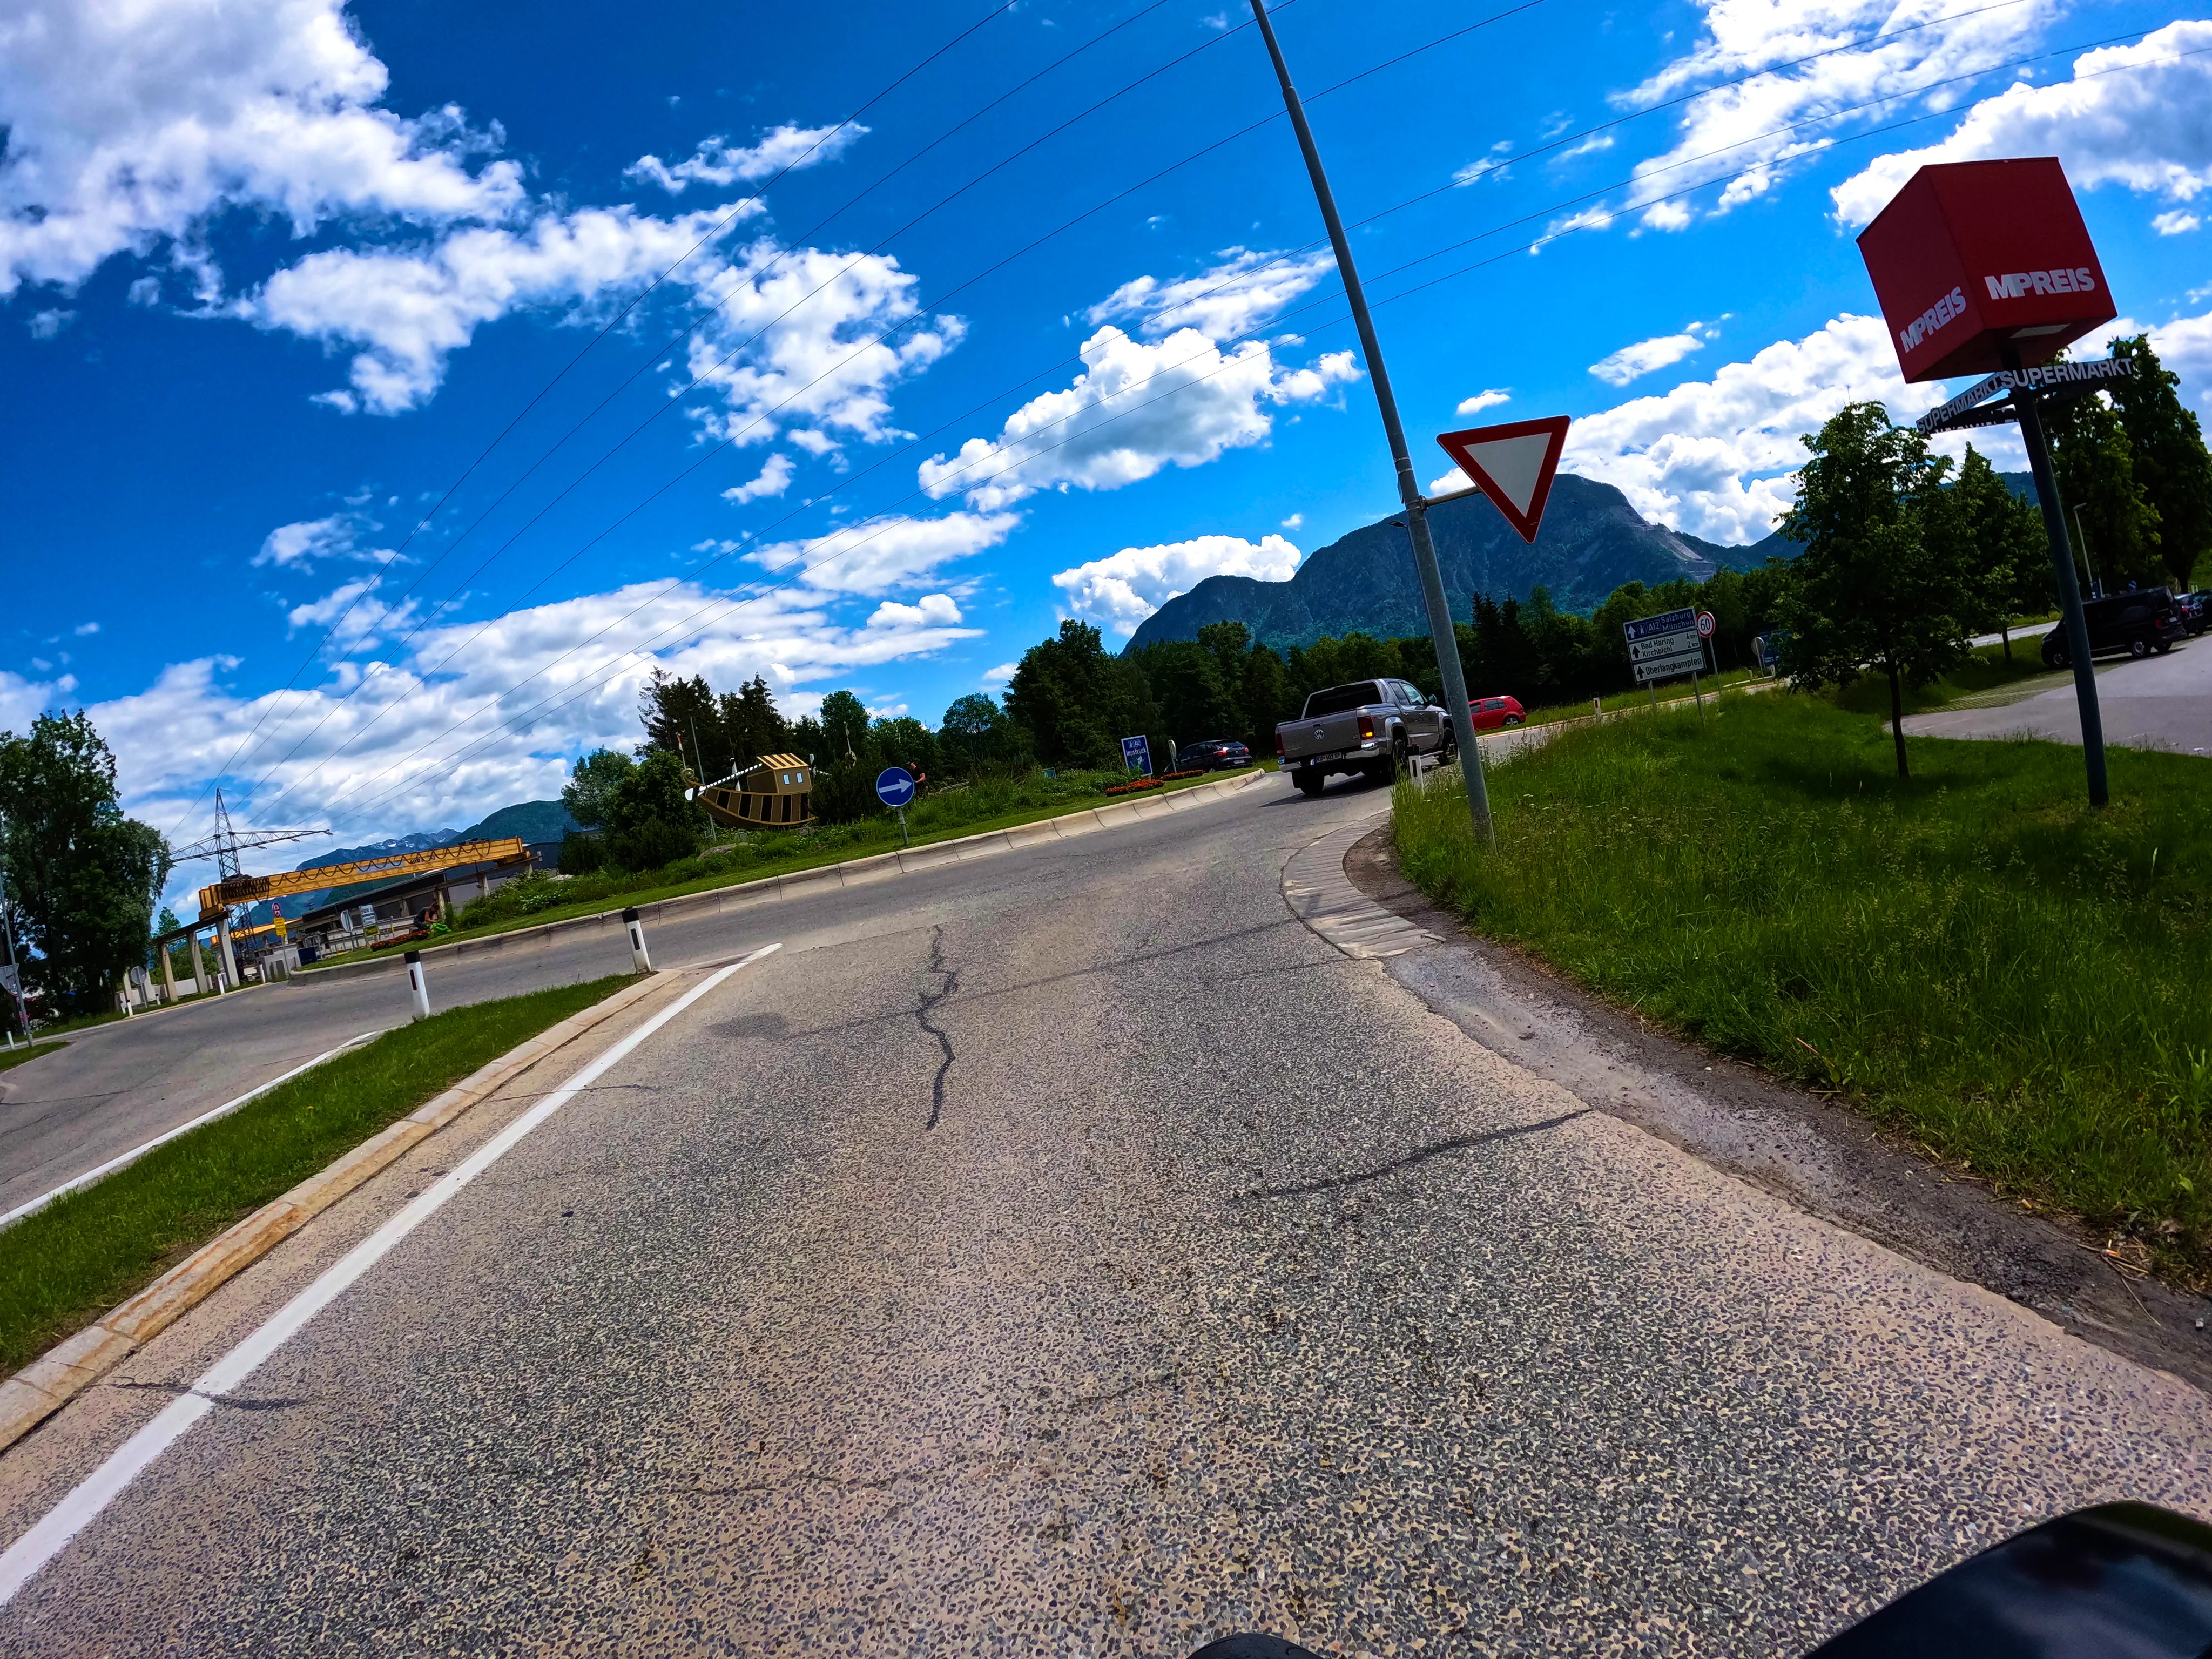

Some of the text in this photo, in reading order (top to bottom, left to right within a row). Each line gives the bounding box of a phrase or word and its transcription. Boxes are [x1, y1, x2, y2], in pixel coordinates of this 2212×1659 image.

[1984, 267, 2095, 300] MPREIS
[1899, 286, 1966, 353] MPREIS
[2000, 358, 2133, 389] SUPERMARKT
[1917, 377, 2002, 433] SUPERMARKT
[1661, 612, 1691, 623] Salzburg
[1649, 622, 1660, 631] A12
[1662, 620, 1694, 631] München
[1700, 618, 1710, 631] 60
[1641, 641, 1653, 650] Bad
[1654, 638, 1674, 647] Häring
[1642, 645, 1673, 657] Kirchbichl
[1645, 657, 1702, 675] Oberlangkampfen
